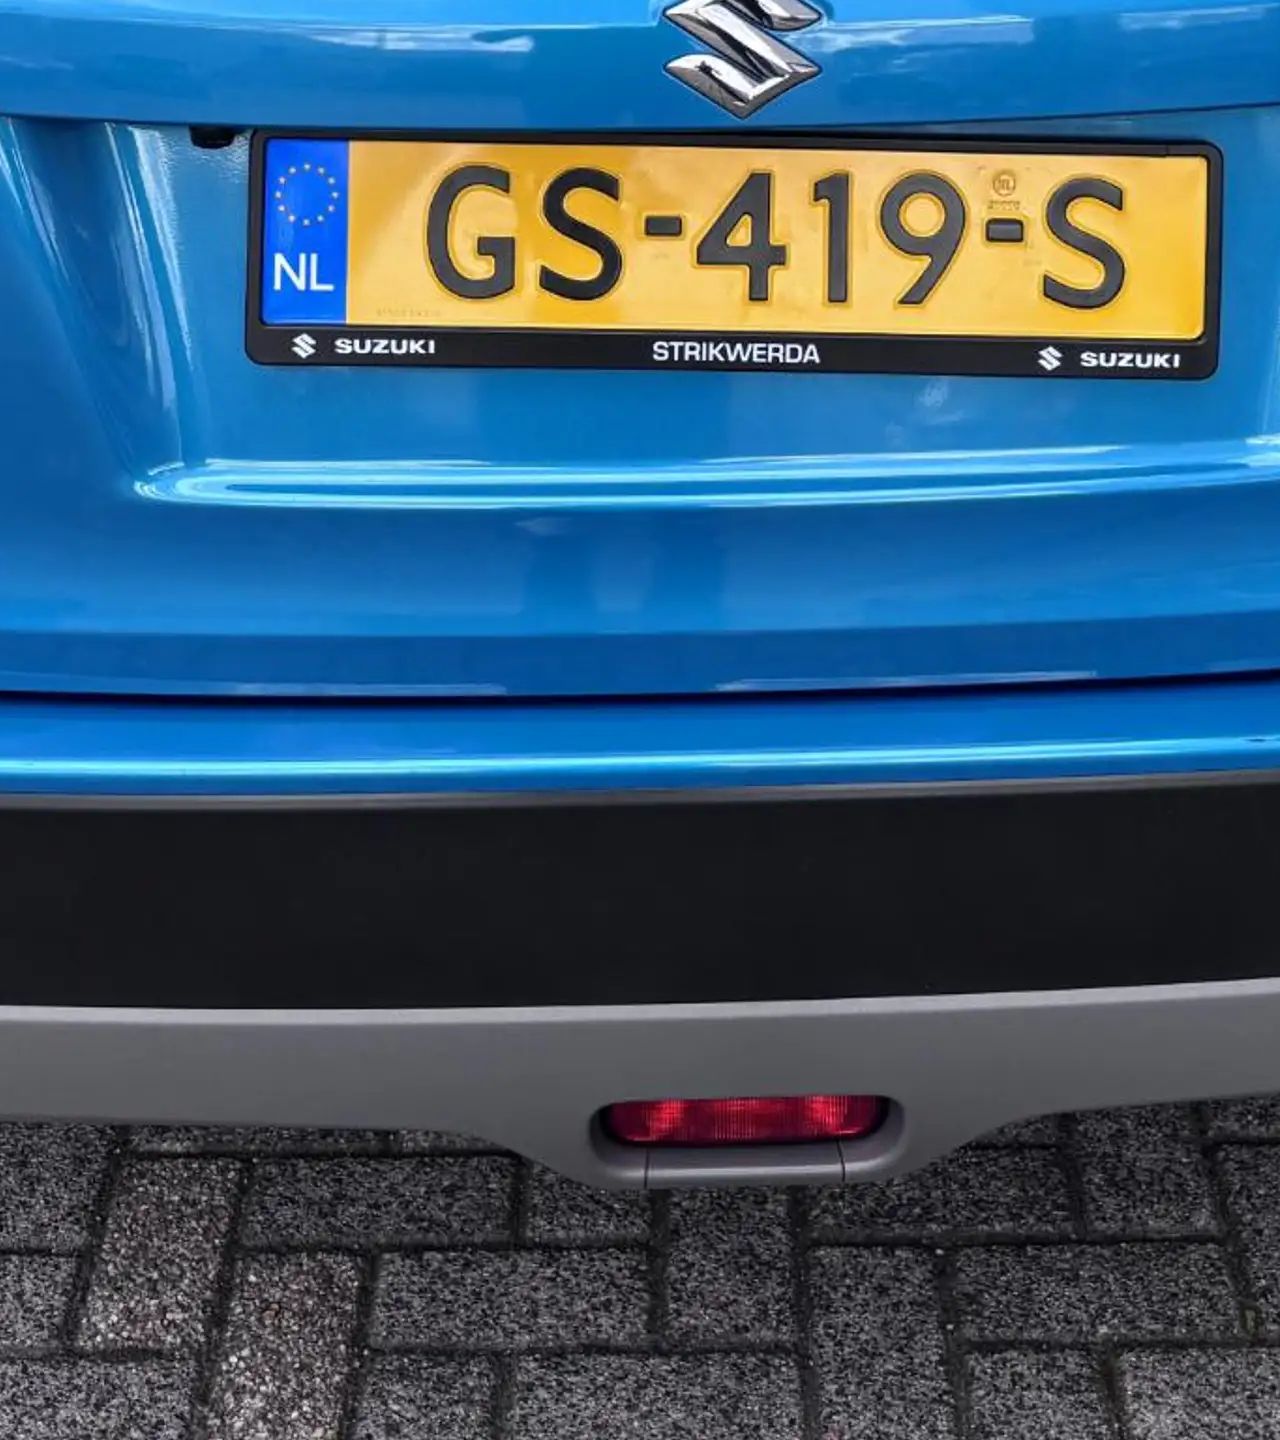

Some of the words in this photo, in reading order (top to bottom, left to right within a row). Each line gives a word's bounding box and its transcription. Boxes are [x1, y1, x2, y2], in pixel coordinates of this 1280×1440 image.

[426, 165, 1125, 309] GS-419-S
[273, 252, 335, 292] NL
[334, 338, 436, 355] SUZUKI
[652, 340, 821, 364] STRIKWERDA
[1080, 351, 1181, 369] SUZUKI
